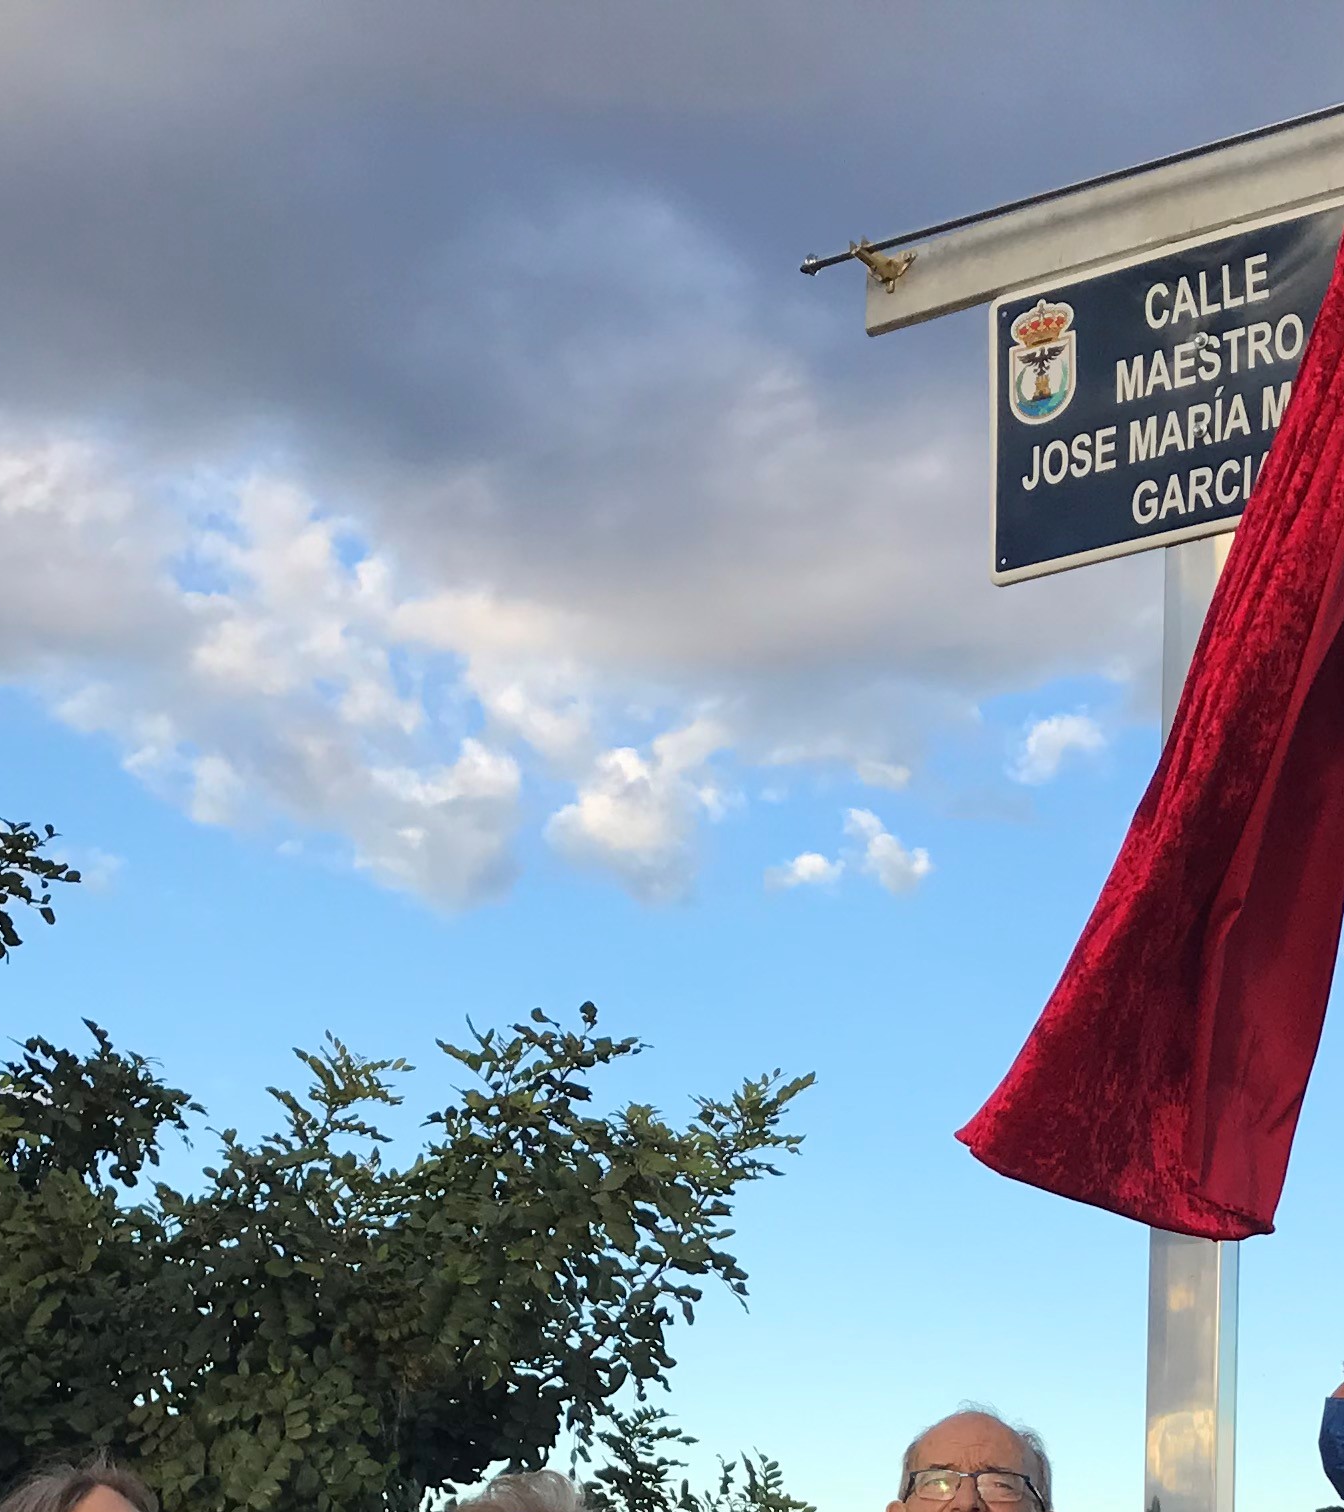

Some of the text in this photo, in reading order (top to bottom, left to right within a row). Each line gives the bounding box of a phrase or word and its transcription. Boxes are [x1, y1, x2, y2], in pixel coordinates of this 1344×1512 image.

[1145, 253, 1270, 329] CALLE
[1116, 313, 1304, 404] MAESTRO
[1022, 426, 1117, 491] JOSE
[1128, 386, 1251, 464] MARÍA
[1132, 450, 1270, 525] GARCI
